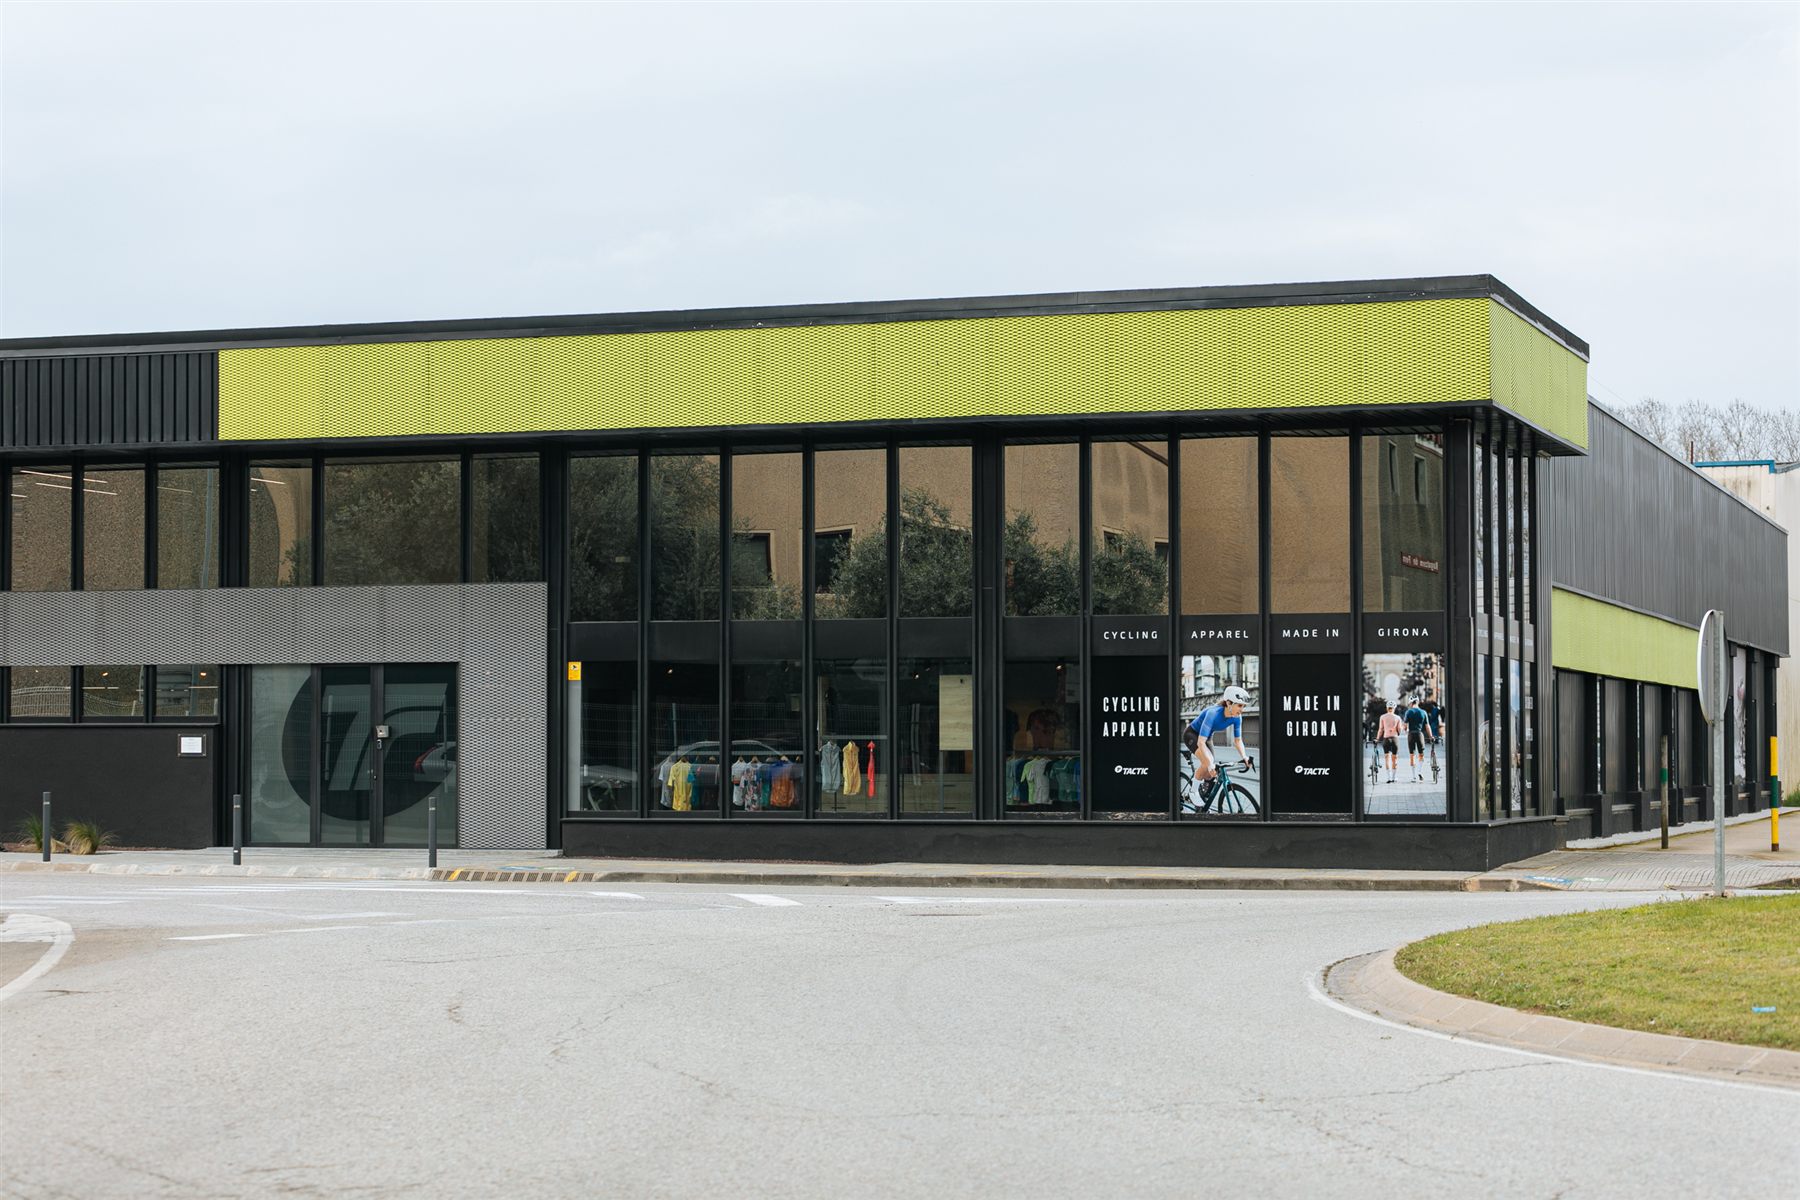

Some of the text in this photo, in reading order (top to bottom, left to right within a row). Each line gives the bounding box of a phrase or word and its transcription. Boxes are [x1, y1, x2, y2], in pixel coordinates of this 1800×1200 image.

[1103, 628, 1429, 640] CYCLING APPAREL MADE IN GIRONA
[1103, 696, 1160, 712] CYCLING
[1283, 695, 1340, 711] MADE IN
[1102, 721, 1160, 737] APPAREL
[1286, 721, 1337, 736] GIRONA
[1122, 767, 1149, 775] TACTIC
[1303, 767, 1330, 775] TACTIC
